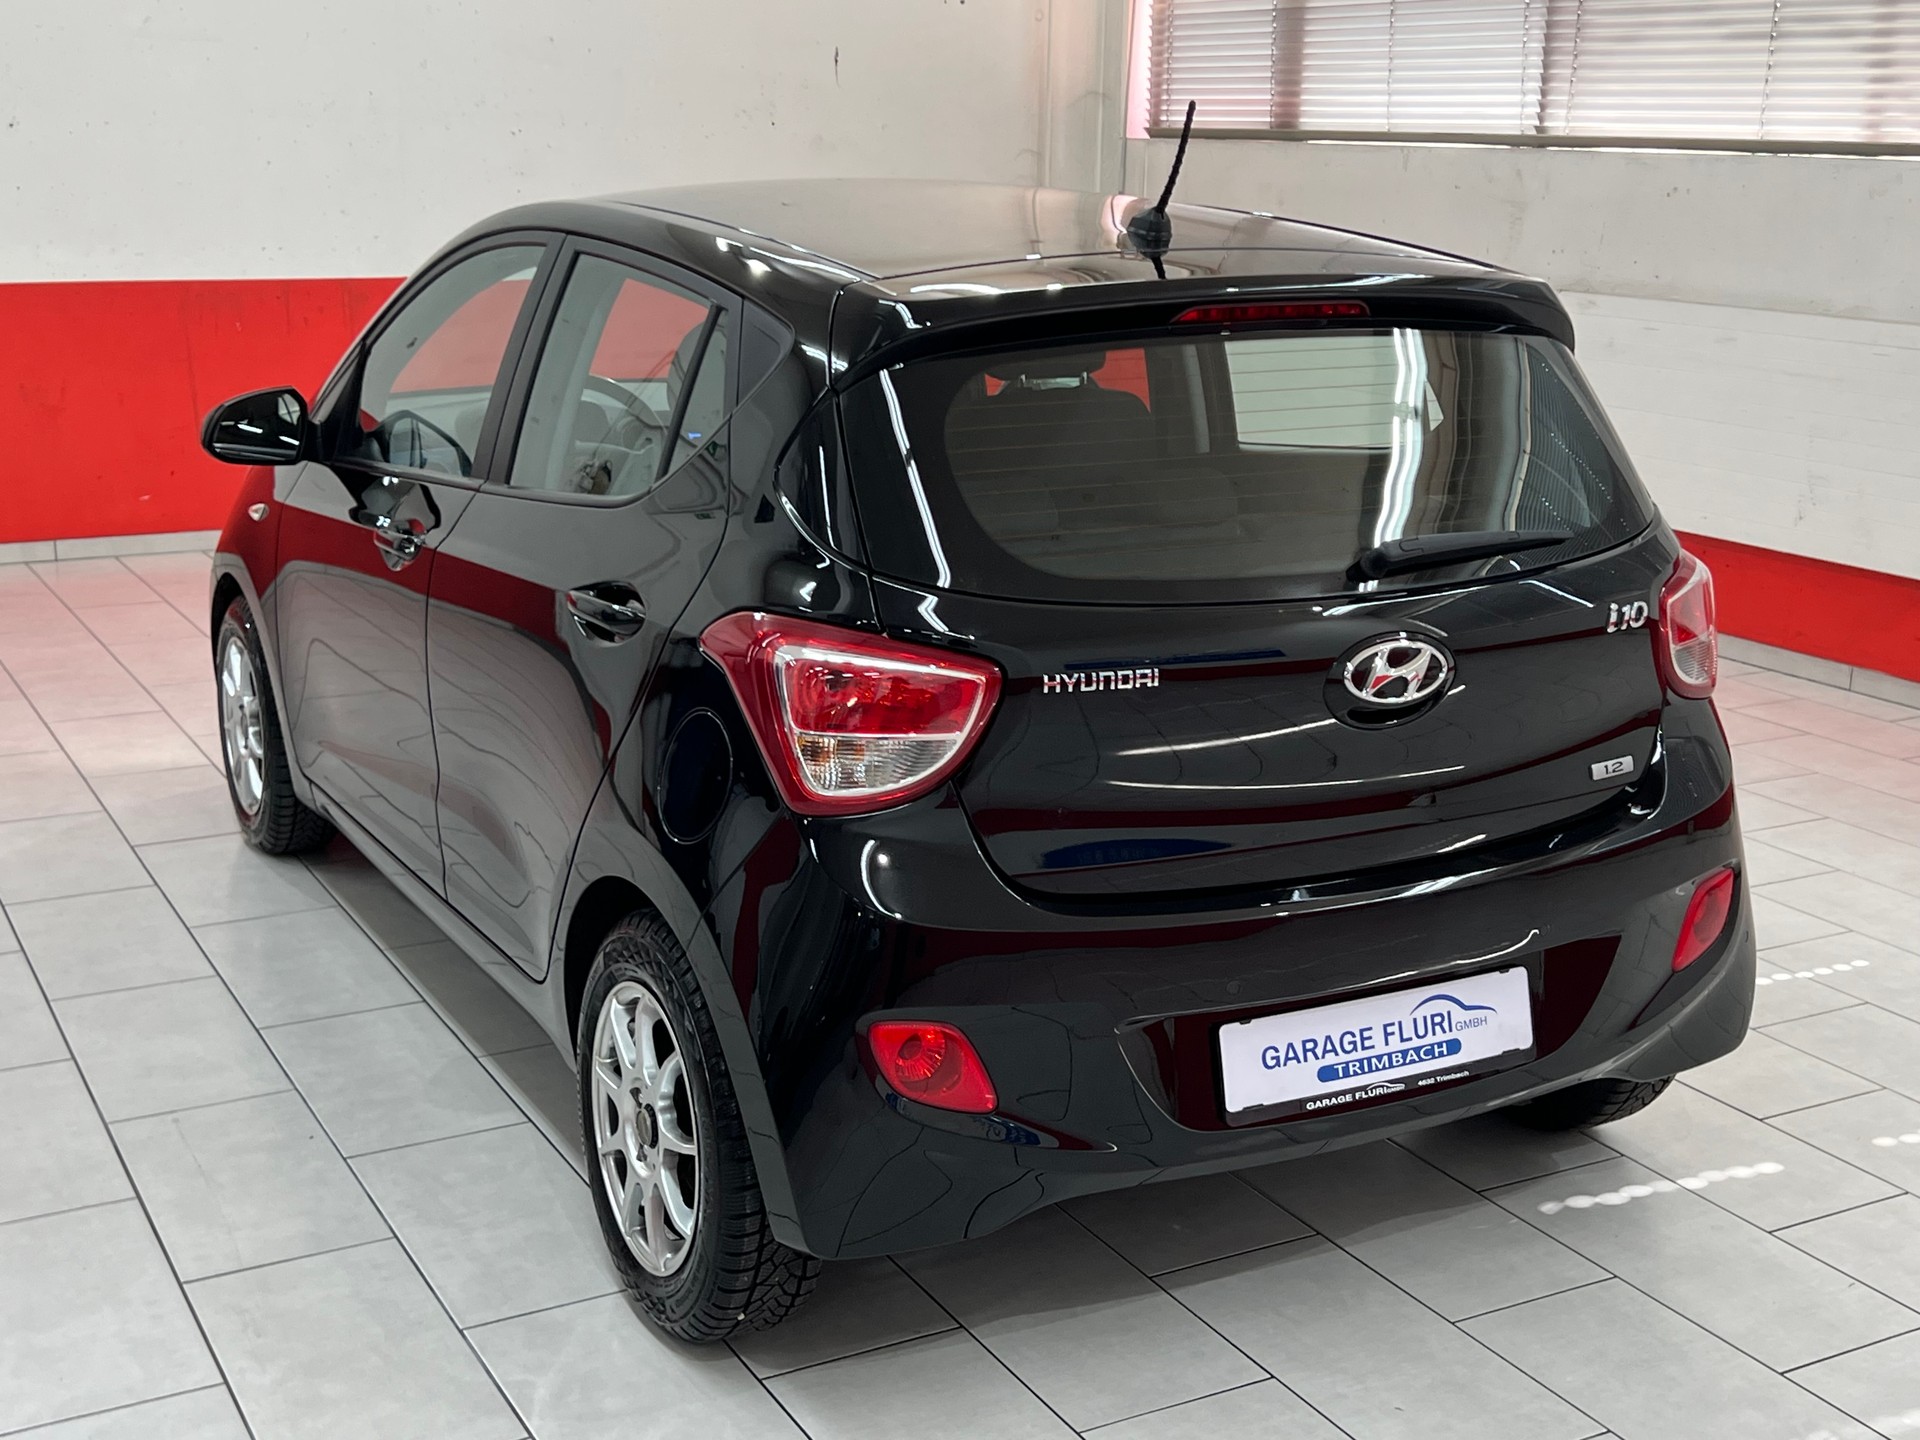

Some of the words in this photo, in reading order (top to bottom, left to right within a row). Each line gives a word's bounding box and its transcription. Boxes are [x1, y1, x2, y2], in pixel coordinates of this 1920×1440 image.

[1607, 601, 1648, 633] i10
[1043, 668, 1159, 693] HYUNDAI
[1261, 1026, 1374, 1070] GARAGE
[1383, 1010, 1453, 1047] FLURI
[1455, 1016, 1488, 1032] GMBH
[1334, 1042, 1448, 1078] TRIMBACH
[1436, 1070, 1470, 1083] Trimbach
[1306, 1094, 1352, 1110] GARAGE
[1355, 1086, 1386, 1100] FLURI
